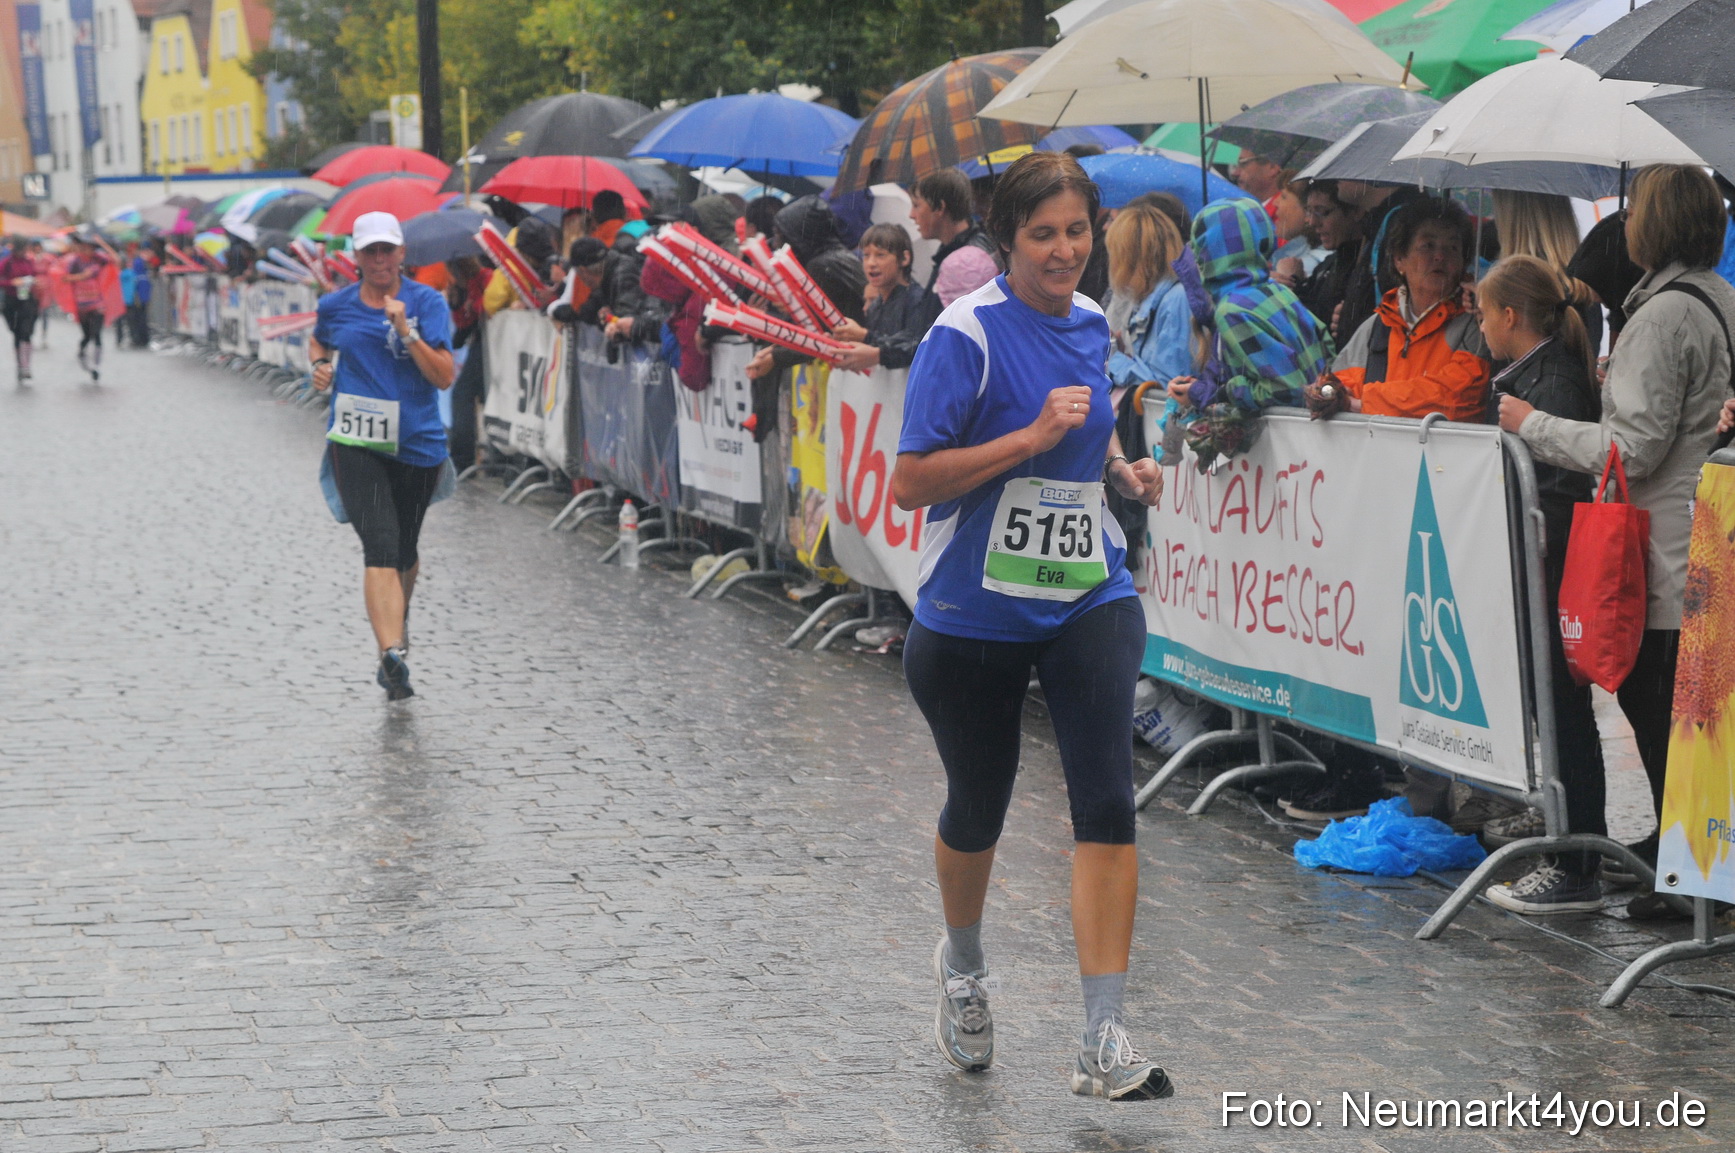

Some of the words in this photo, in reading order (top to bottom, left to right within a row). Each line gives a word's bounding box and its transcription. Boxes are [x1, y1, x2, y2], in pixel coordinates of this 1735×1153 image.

[341, 411, 388, 440] 5111
[1004, 506, 1093, 559] 5153
[1036, 565, 1065, 584] Eva
[1560, 615, 1583, 639] Club
[1467, 737, 1494, 764] GmbH
